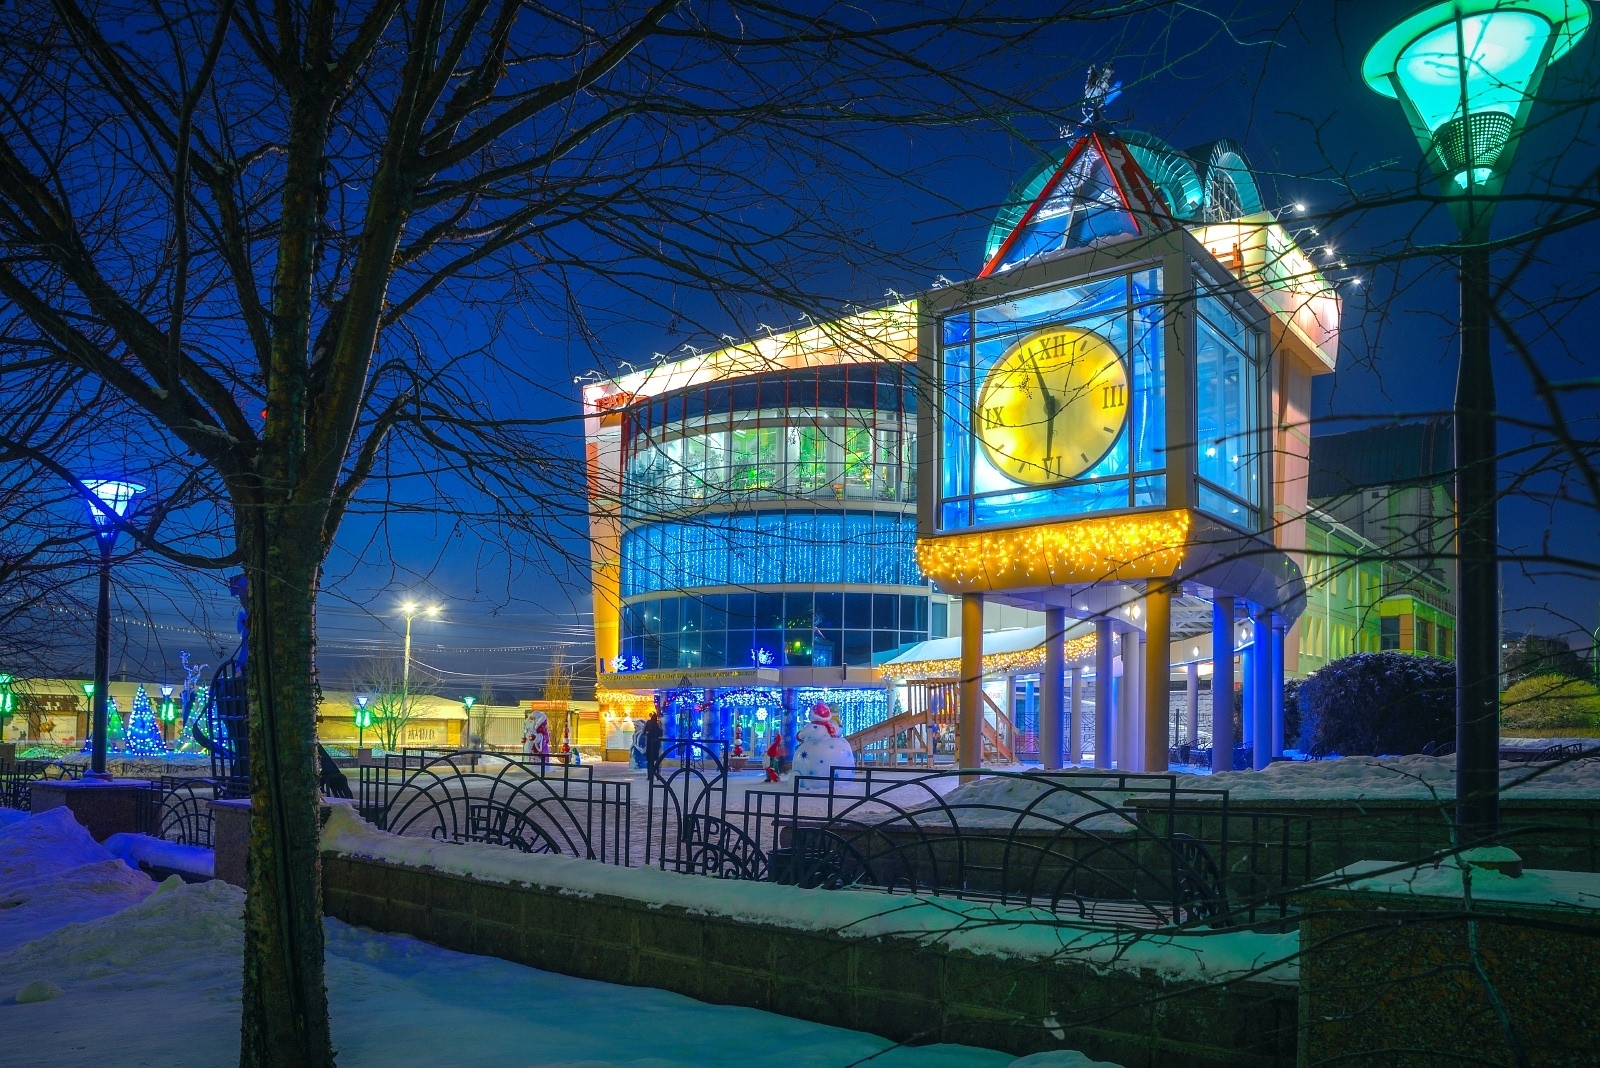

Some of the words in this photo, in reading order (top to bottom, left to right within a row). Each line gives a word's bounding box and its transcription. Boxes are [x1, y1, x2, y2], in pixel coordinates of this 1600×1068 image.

[1038, 334, 1067, 361] XII
[1102, 384, 1124, 409] III
[985, 406, 1005, 430] IX
[1042, 456, 1063, 479] VI
